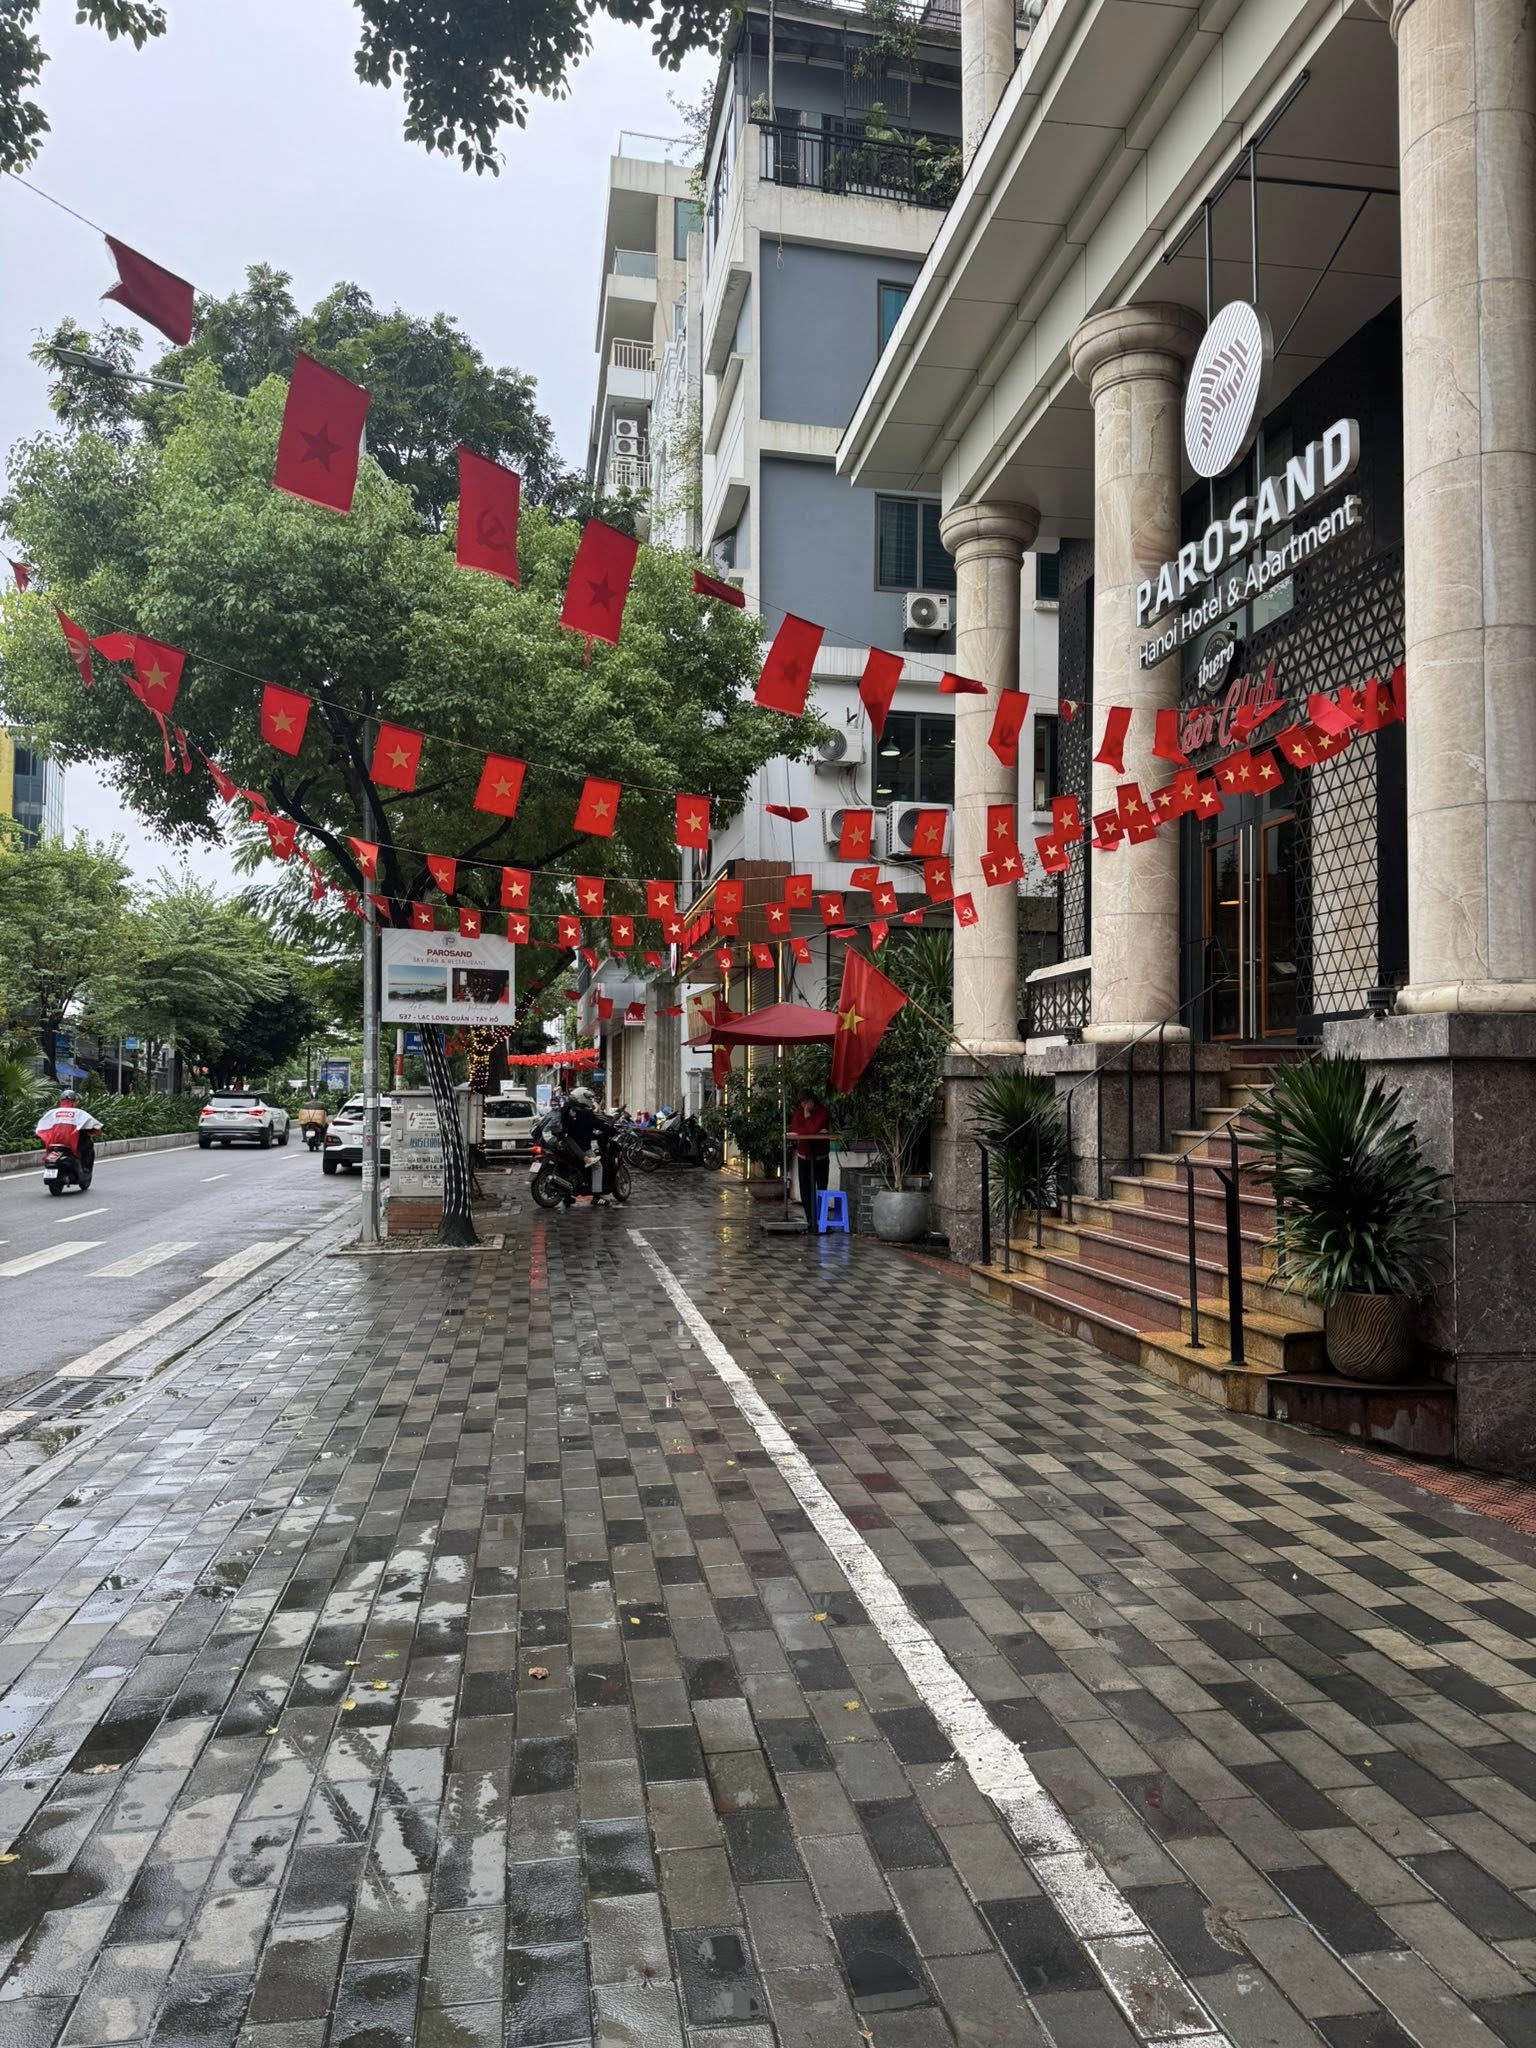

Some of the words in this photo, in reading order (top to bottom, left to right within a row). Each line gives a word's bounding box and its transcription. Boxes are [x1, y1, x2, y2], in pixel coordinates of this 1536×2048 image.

[1136, 418, 1359, 627] PAROSAND
[1139, 618, 1179, 669] Hanoi
[1181, 586, 1223, 641] Hotel
[1226, 577, 1240, 607] &
[1244, 495, 1356, 596] Apartment
[426, 948, 473, 958] PAROSAND
